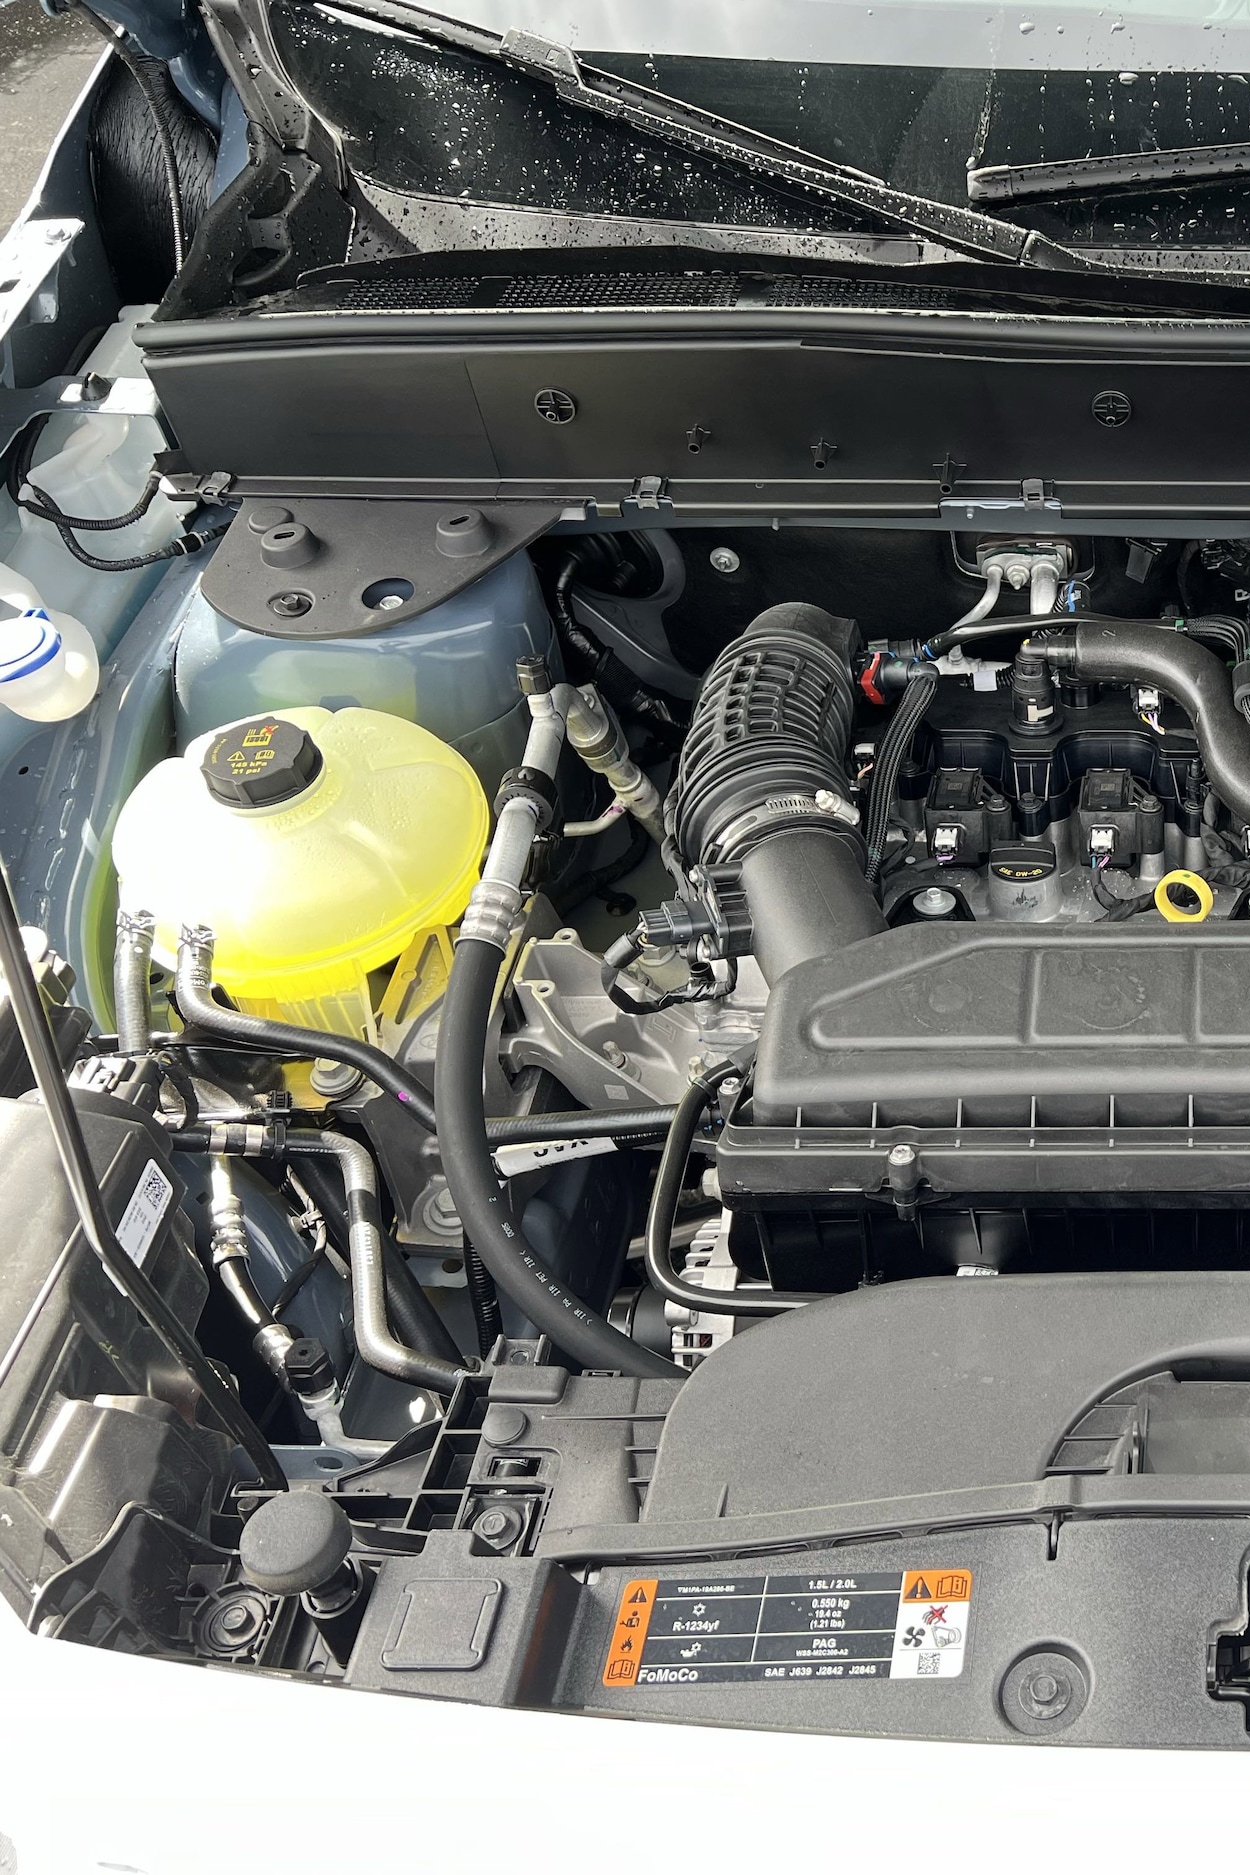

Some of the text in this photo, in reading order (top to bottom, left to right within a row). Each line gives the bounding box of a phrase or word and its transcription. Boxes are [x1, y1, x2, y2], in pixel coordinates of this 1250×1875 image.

[998, 867, 1013, 876] SAE
[535, 1271, 548, 1283] PET
[808, 1580, 828, 1590] 1.5L
[835, 1579, 857, 1589] 2.0L
[811, 1598, 850, 1610] 0.550 kg
[814, 1610, 831, 1618] 19.4
[672, 1619, 719, 1633] R-1234yf
[809, 1618, 845, 1629] (1.21 lbs)
[812, 1638, 837, 1649] PAG
[637, 1668, 698, 1683] FoMoCo
[764, 1664, 877, 1677] SAE J639 J2842 J2845
